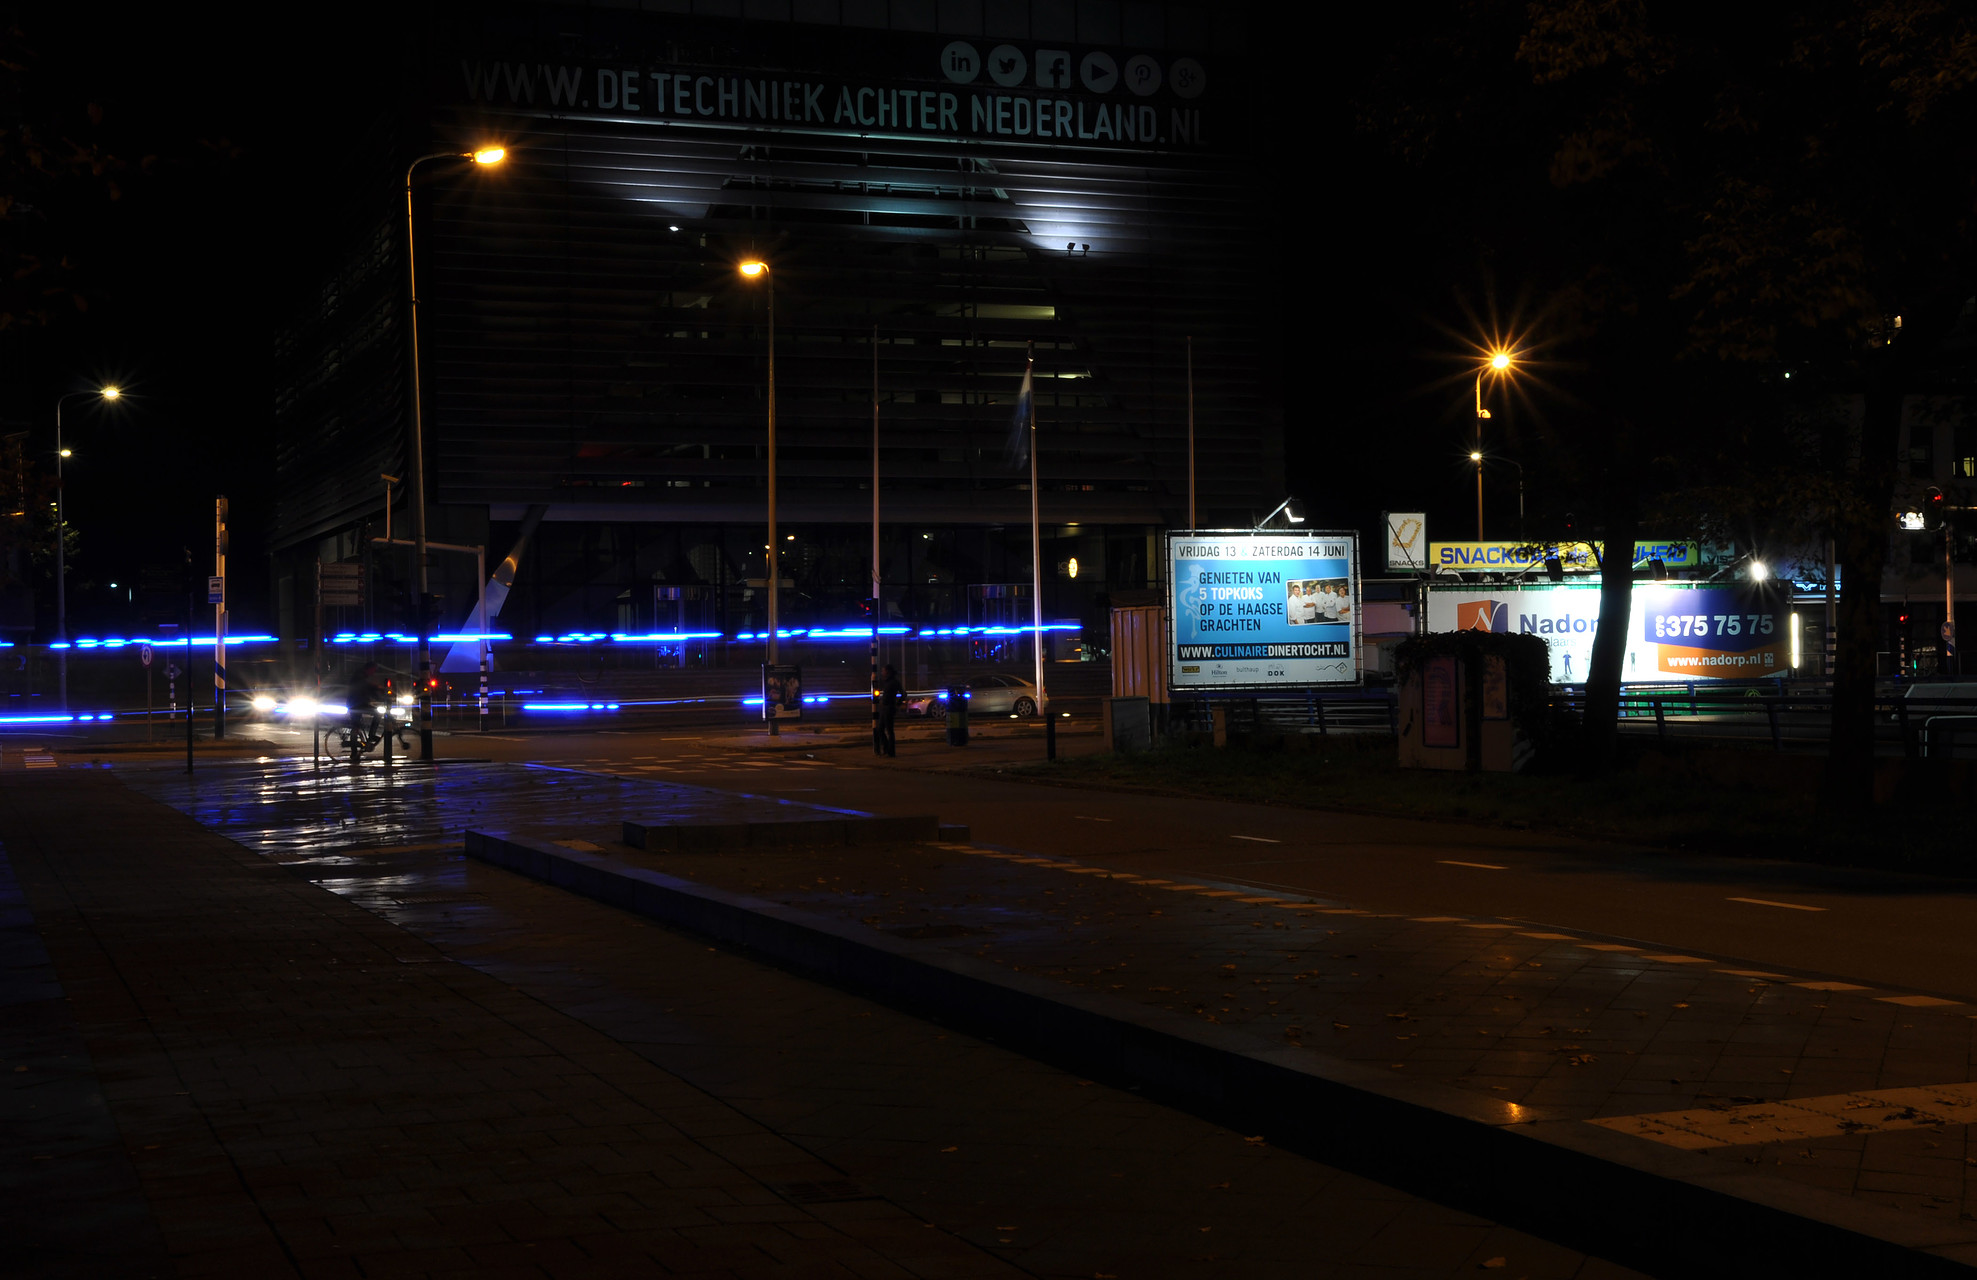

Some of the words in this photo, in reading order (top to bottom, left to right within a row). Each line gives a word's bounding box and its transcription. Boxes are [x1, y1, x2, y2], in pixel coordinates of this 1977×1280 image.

[650, 72, 826, 124] TECHNIEK
[833, 84, 959, 132] ACHTER
[971, 94, 1208, 145] NEDERLAND.NL
[1179, 546, 1220, 557] VRIJDAG
[1225, 546, 1236, 556] 13
[1252, 546, 1303, 557] ZATERDAG
[1309, 546, 1320, 556] 14
[1323, 545, 1345, 556] JUNI
[1199, 572, 1253, 584] GENIETEN
[1258, 571, 1280, 584] VAN
[1199, 587, 1207, 600] 5
[1211, 587, 1264, 600] TOPKOKS
[1200, 603, 1215, 616] OP
[1219, 603, 1233, 615] DE
[1238, 603, 1283, 615] HAAGSE
[1200, 619, 1261, 632] GRACHTEN
[1520, 613, 1600, 634] Nador
[1665, 615, 1708, 637] 375
[1714, 615, 1741, 636] 75
[1747, 614, 1774, 634] 75
[1180, 644, 1347, 658] WWW.CULINAIREDINERTOCHT.NL
[1667, 653, 1761, 667] www.nadorp.nl
